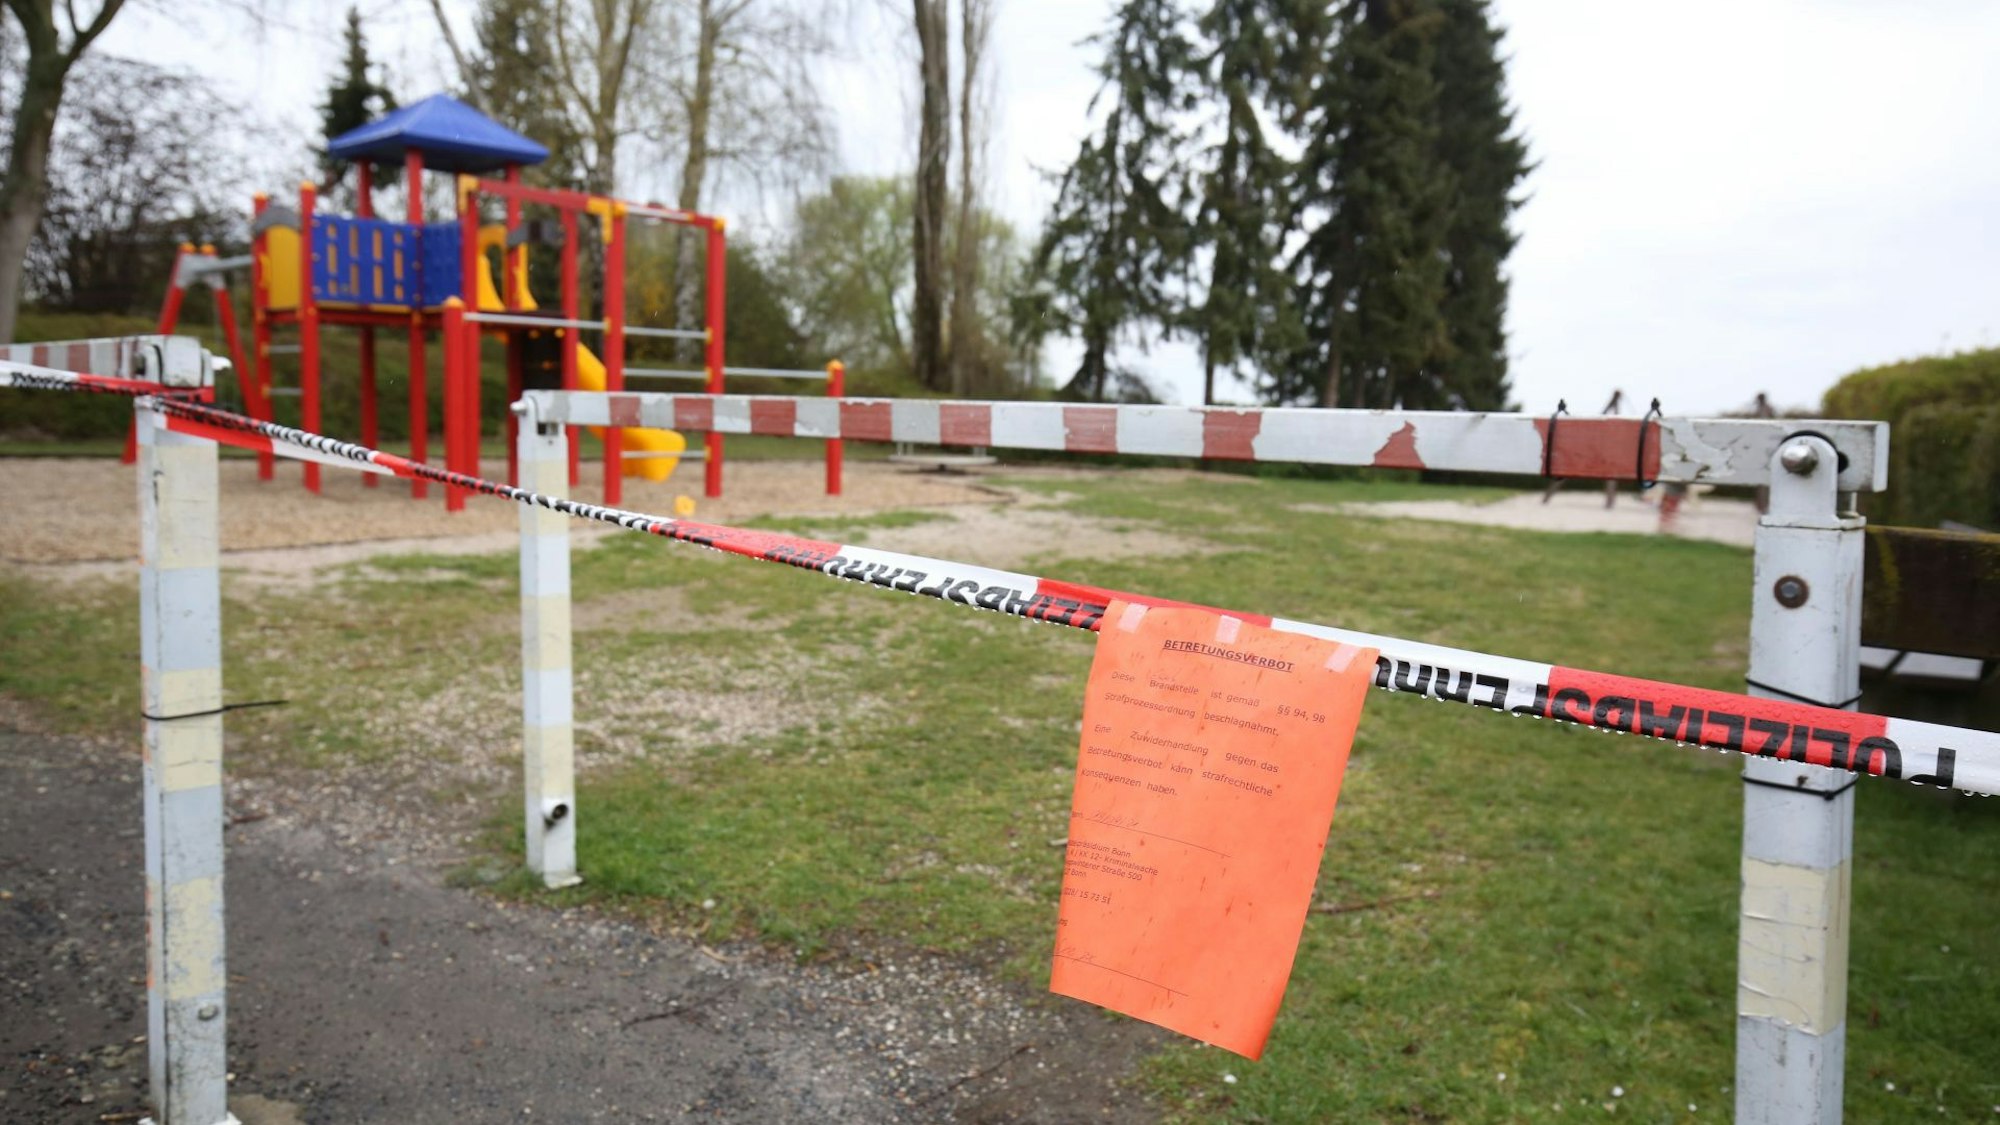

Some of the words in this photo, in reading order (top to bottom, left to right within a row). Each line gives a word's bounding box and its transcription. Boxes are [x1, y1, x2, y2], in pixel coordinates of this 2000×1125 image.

[1163, 639, 1294, 672] BETRETUNGSVERBOT
[1104, 692, 1196, 719] Strafprozessordnung
[1111, 671, 1135, 682] Diese
[1149, 679, 1200, 695] Brandstelle
[1210, 689, 1223, 700] ist
[1277, 703, 1292, 716] §§
[1293, 707, 1309, 722] 94,
[1312, 711, 1326, 724] 98
[1130, 730, 1209, 756] Zuwiderhandlung
[1225, 751, 1256, 768] gegen
[1260, 761, 1280, 773] das
[1087, 746, 1163, 770] Betretungsverbot
[1170, 763, 1193, 775] kann
[1201, 769, 1273, 796] strafrechtliche
[1104, 856, 1158, 876] Kriminalwache
[1111, 847, 1131, 858] Bonn
[1101, 863, 1126, 878] Straße
[1127, 870, 1143, 881] 500
